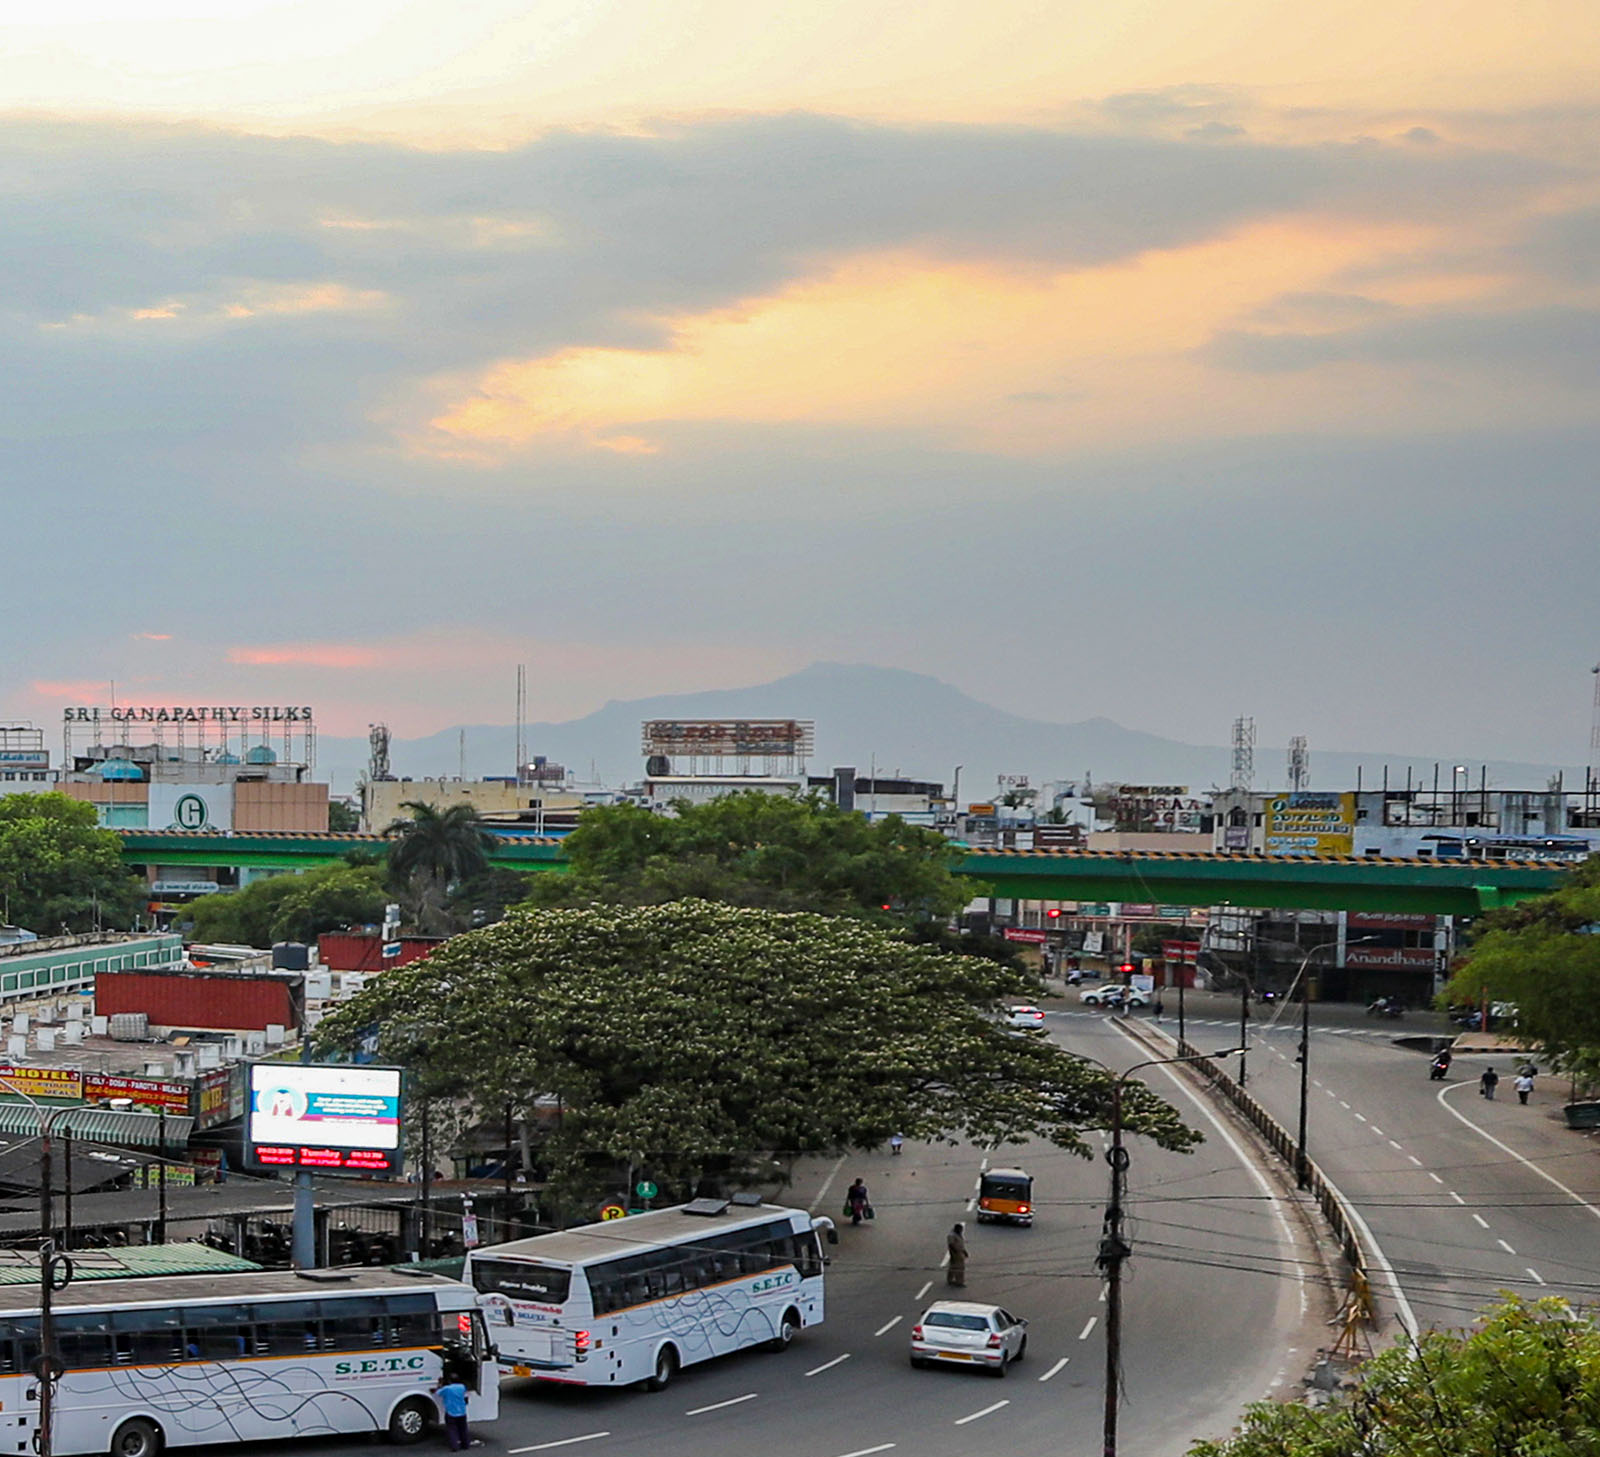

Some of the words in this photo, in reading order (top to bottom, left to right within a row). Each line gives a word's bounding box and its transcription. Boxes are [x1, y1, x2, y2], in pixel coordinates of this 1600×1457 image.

[64, 707, 99, 721] SRI
[111, 707, 241, 721] GANAPATHY
[252, 706, 312, 720] SILKS
[182, 800, 202, 829] G
[14, 1068, 70, 1081] HOTEL
[335, 1356, 424, 1375] S.E.T.C
